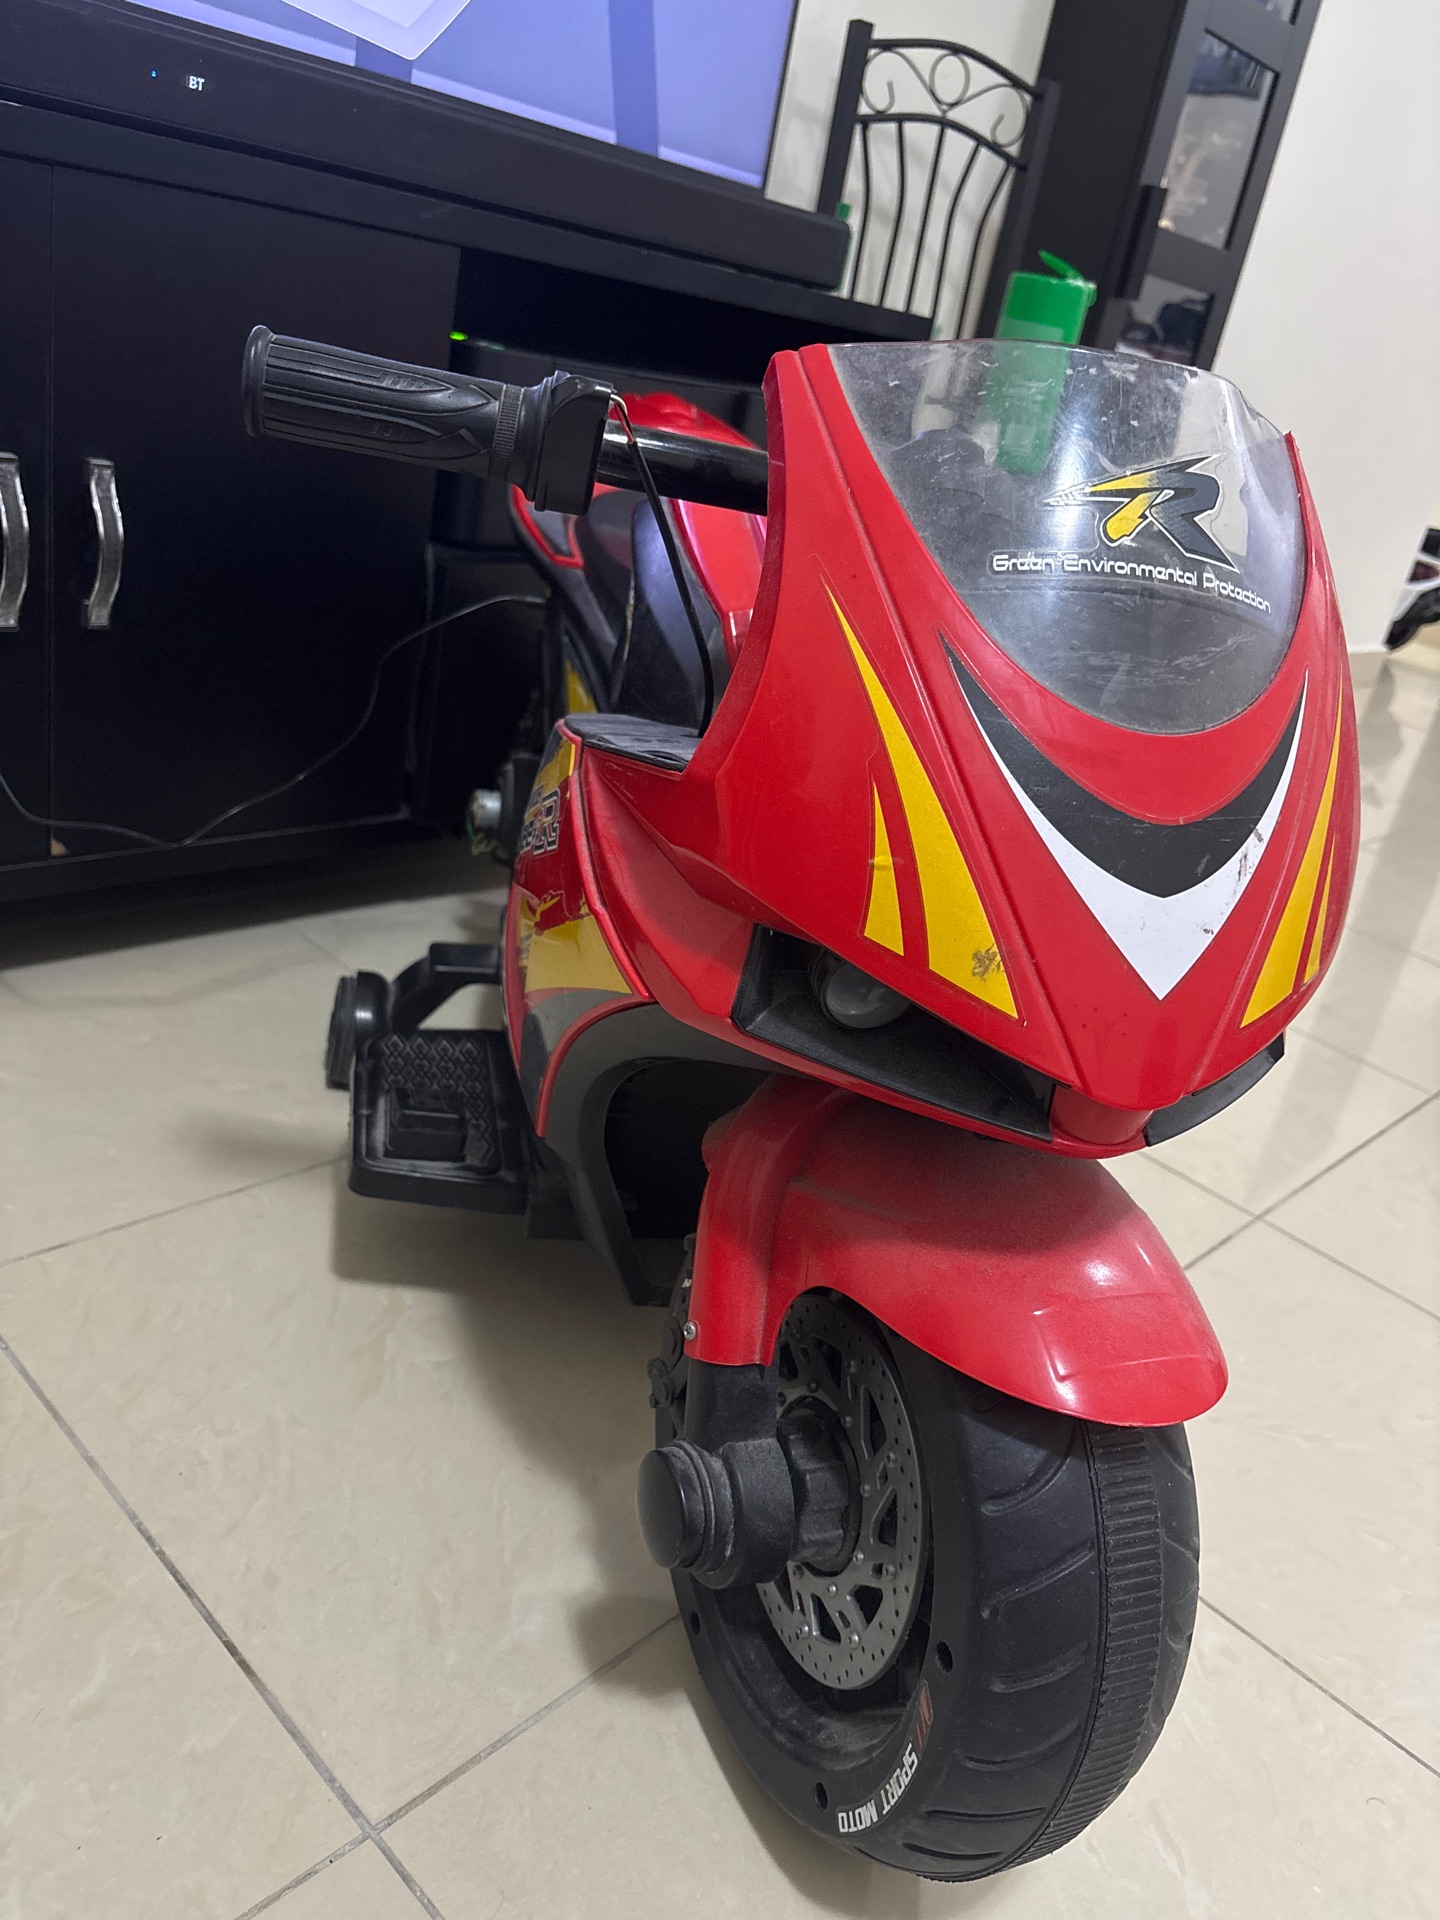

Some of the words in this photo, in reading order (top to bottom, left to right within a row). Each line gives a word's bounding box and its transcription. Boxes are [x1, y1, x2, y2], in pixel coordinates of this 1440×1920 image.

[188, 75, 205, 91] BT
[992, 554, 1056, 572] Green
[1063, 553, 1198, 587] Environmental
[1203, 572, 1272, 614] Protection
[880, 1742, 919, 1816] SPORT
[837, 1799, 879, 1833] MOTO
